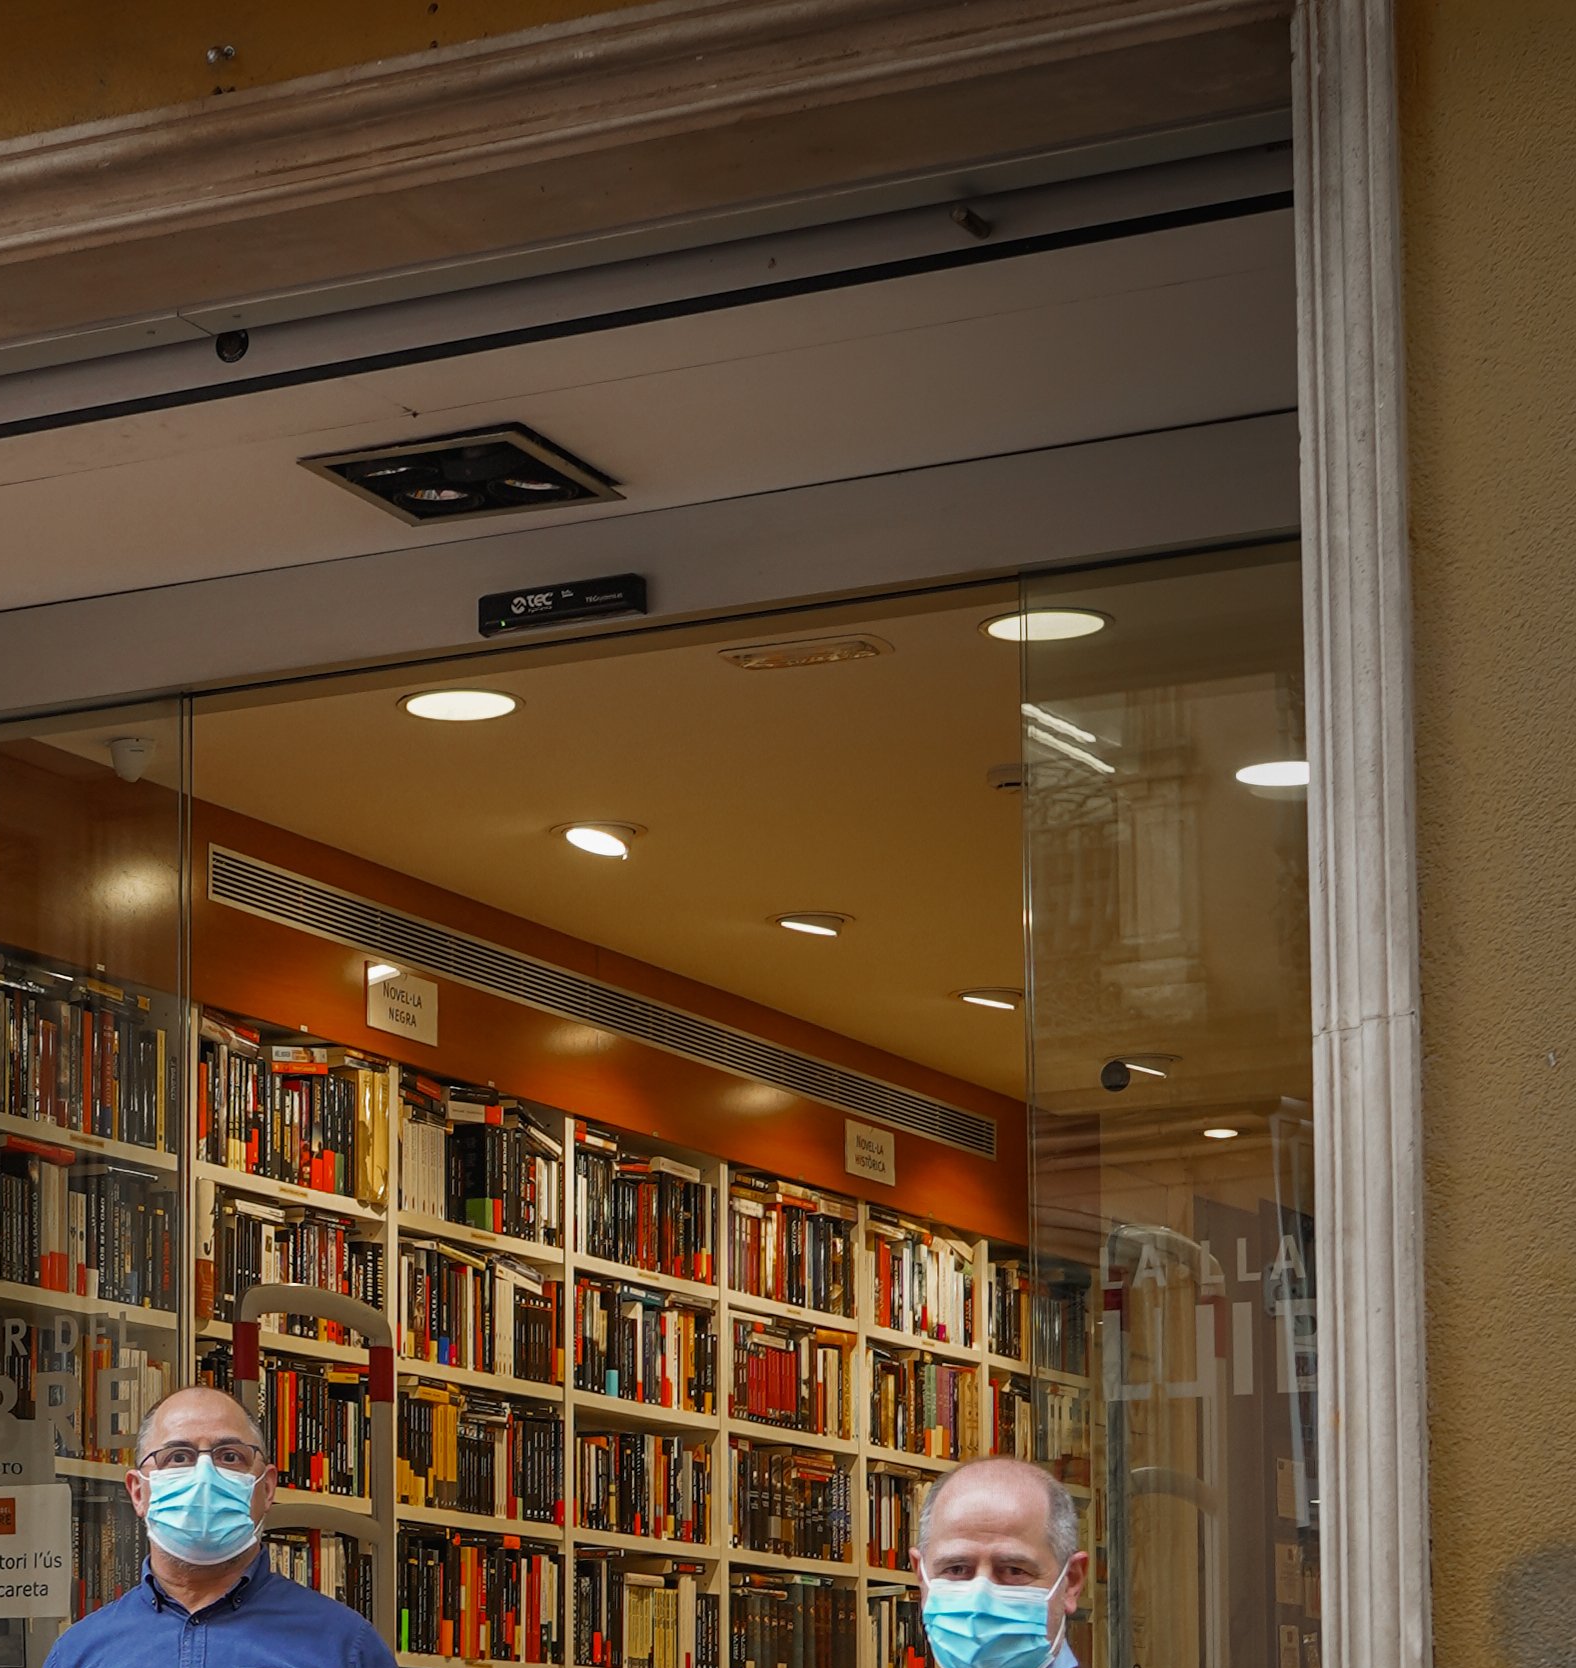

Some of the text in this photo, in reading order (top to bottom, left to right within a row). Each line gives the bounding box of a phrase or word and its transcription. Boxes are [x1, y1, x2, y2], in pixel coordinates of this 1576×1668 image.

[388, 1006, 417, 1028] NEGRA
[1101, 1243, 1167, 1289] LA
[54, 1311, 138, 1354] DEL
